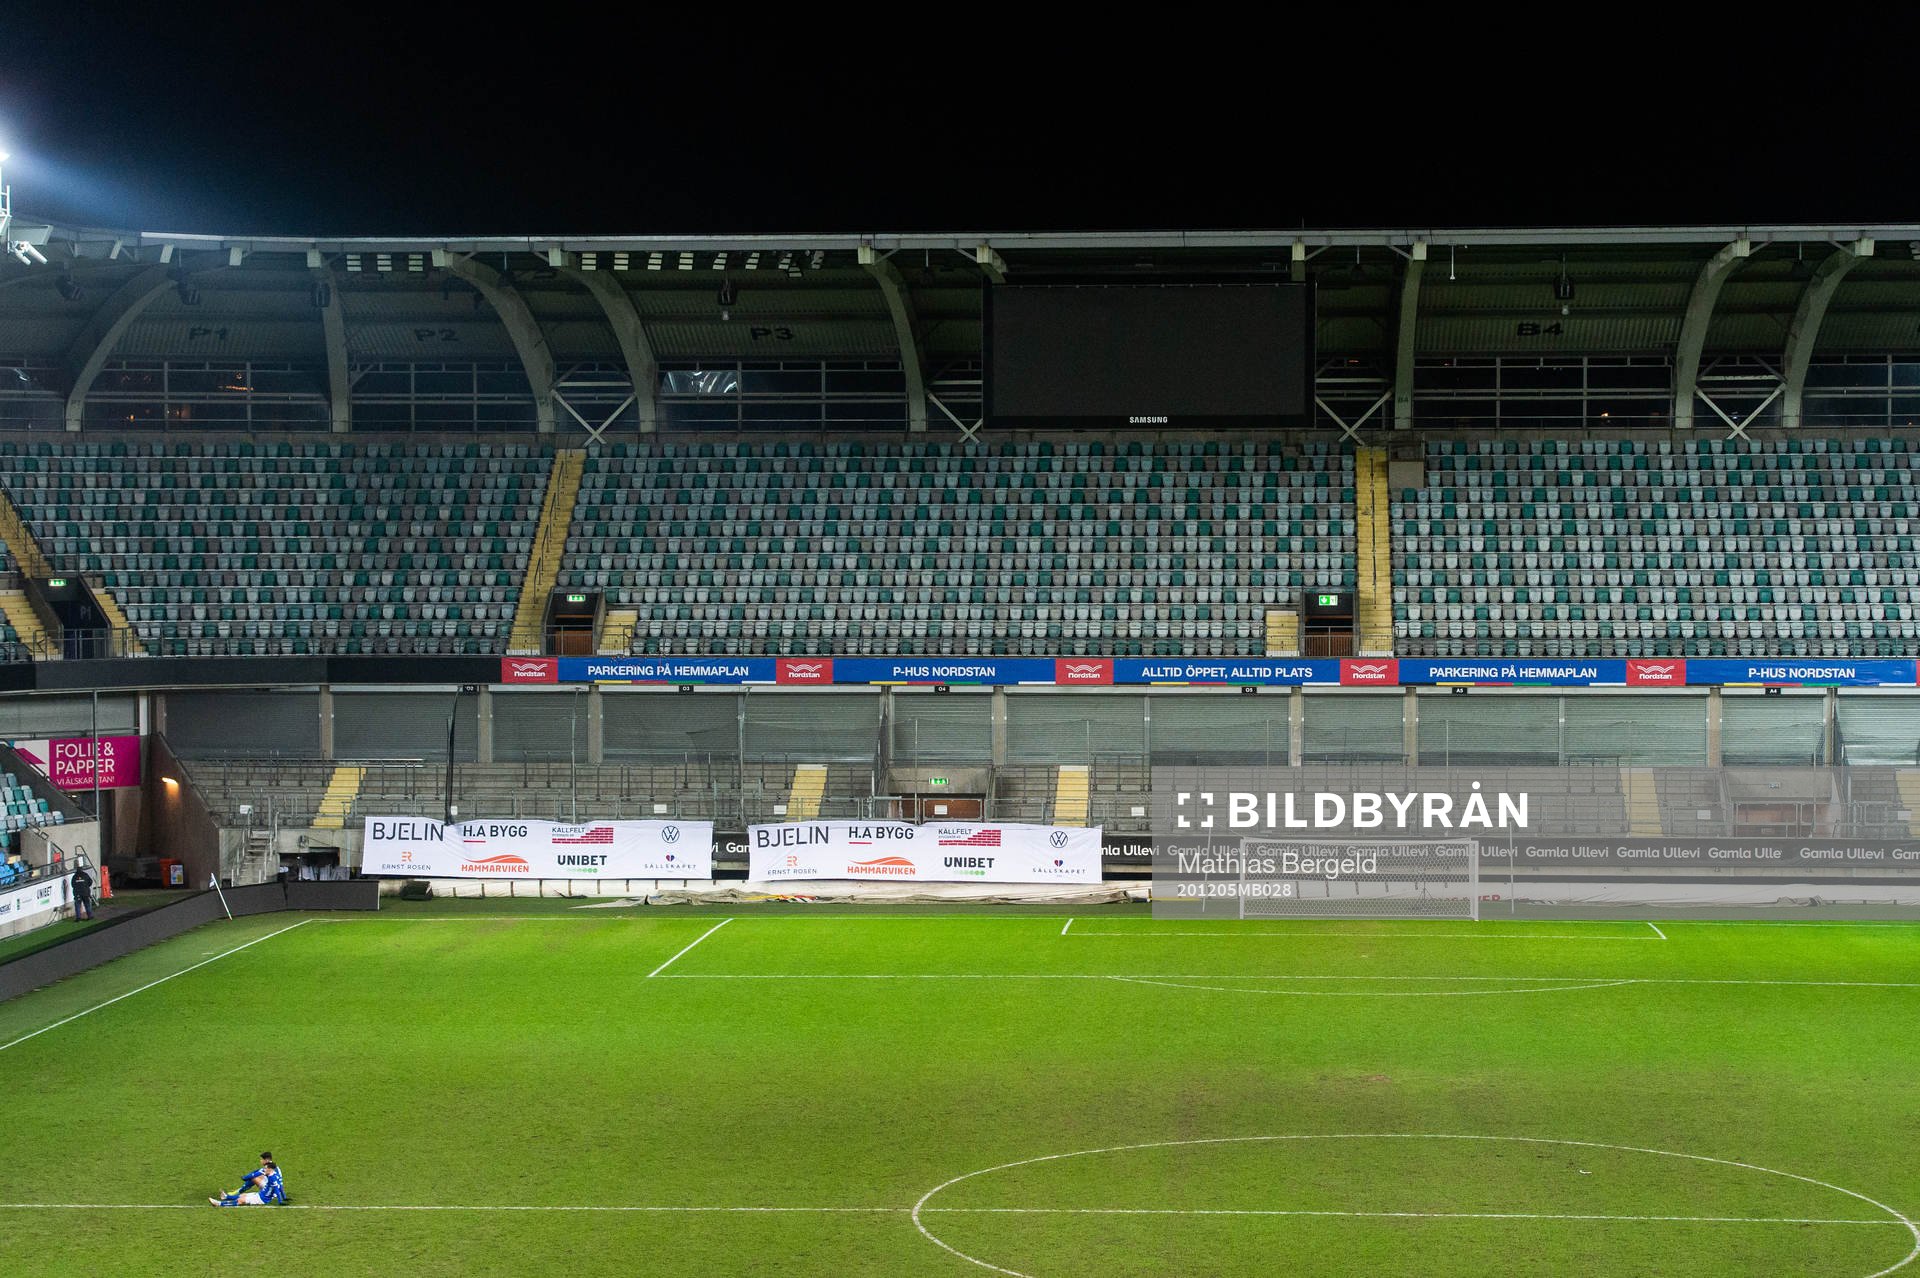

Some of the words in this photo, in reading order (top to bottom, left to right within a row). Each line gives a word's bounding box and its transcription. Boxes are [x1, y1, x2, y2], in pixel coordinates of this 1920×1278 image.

[414, 328, 459, 341] P2
[750, 327, 794, 340] P3
[1516, 323, 1563, 336] B4
[1129, 416, 1168, 424] SAMSUNG
[588, 666, 653, 676] PARKERING
[657, 662, 671, 676] PÅ
[674, 666, 749, 677] HEMMAPLAN
[893, 666, 929, 677] P-HUS
[932, 666, 996, 677] NORDSTAN
[1142, 667, 1182, 677] ALLTID
[1231, 667, 1272, 677] ALLTID
[1275, 667, 1313, 678] PLATS
[1430, 667, 1497, 677] PARKERING
[1501, 663, 1516, 677] PÅ
[1519, 667, 1597, 678] HEMMAPLAN
[1749, 668, 1786, 678] P-HUS
[1789, 668, 1855, 678] NORDSTAN
[104, 742, 114, 756] &
[56, 759, 115, 775] PAPPER
[373, 822, 444, 842] BJELIN
[463, 825, 485, 837] H.A
[490, 825, 528, 837] BYGG
[757, 826, 829, 848] BJELIN
[848, 827, 872, 839] H.A
[875, 827, 914, 840] BYGG
[1123, 845, 1160, 856] Ullevi
[1392, 846, 1429, 857] Ullevi
[1481, 846, 1518, 857] Ullevi
[1526, 846, 1568, 858] Gamla
[1571, 846, 1609, 858] Ullevi
[1616, 846, 1659, 858] Gamla
[1663, 847, 1700, 858] Ullevi
[1708, 847, 1751, 859] Gamla
[1754, 847, 1782, 859] Ulle
[1800, 847, 1843, 859] Gamla
[1847, 848, 1884, 859] Ullevi
[557, 855, 607, 865] UNIBET
[944, 857, 995, 868] UNIBET
[461, 864, 529, 872] HAMMARVIKEN
[847, 866, 916, 875] HAMMARVIKEN
